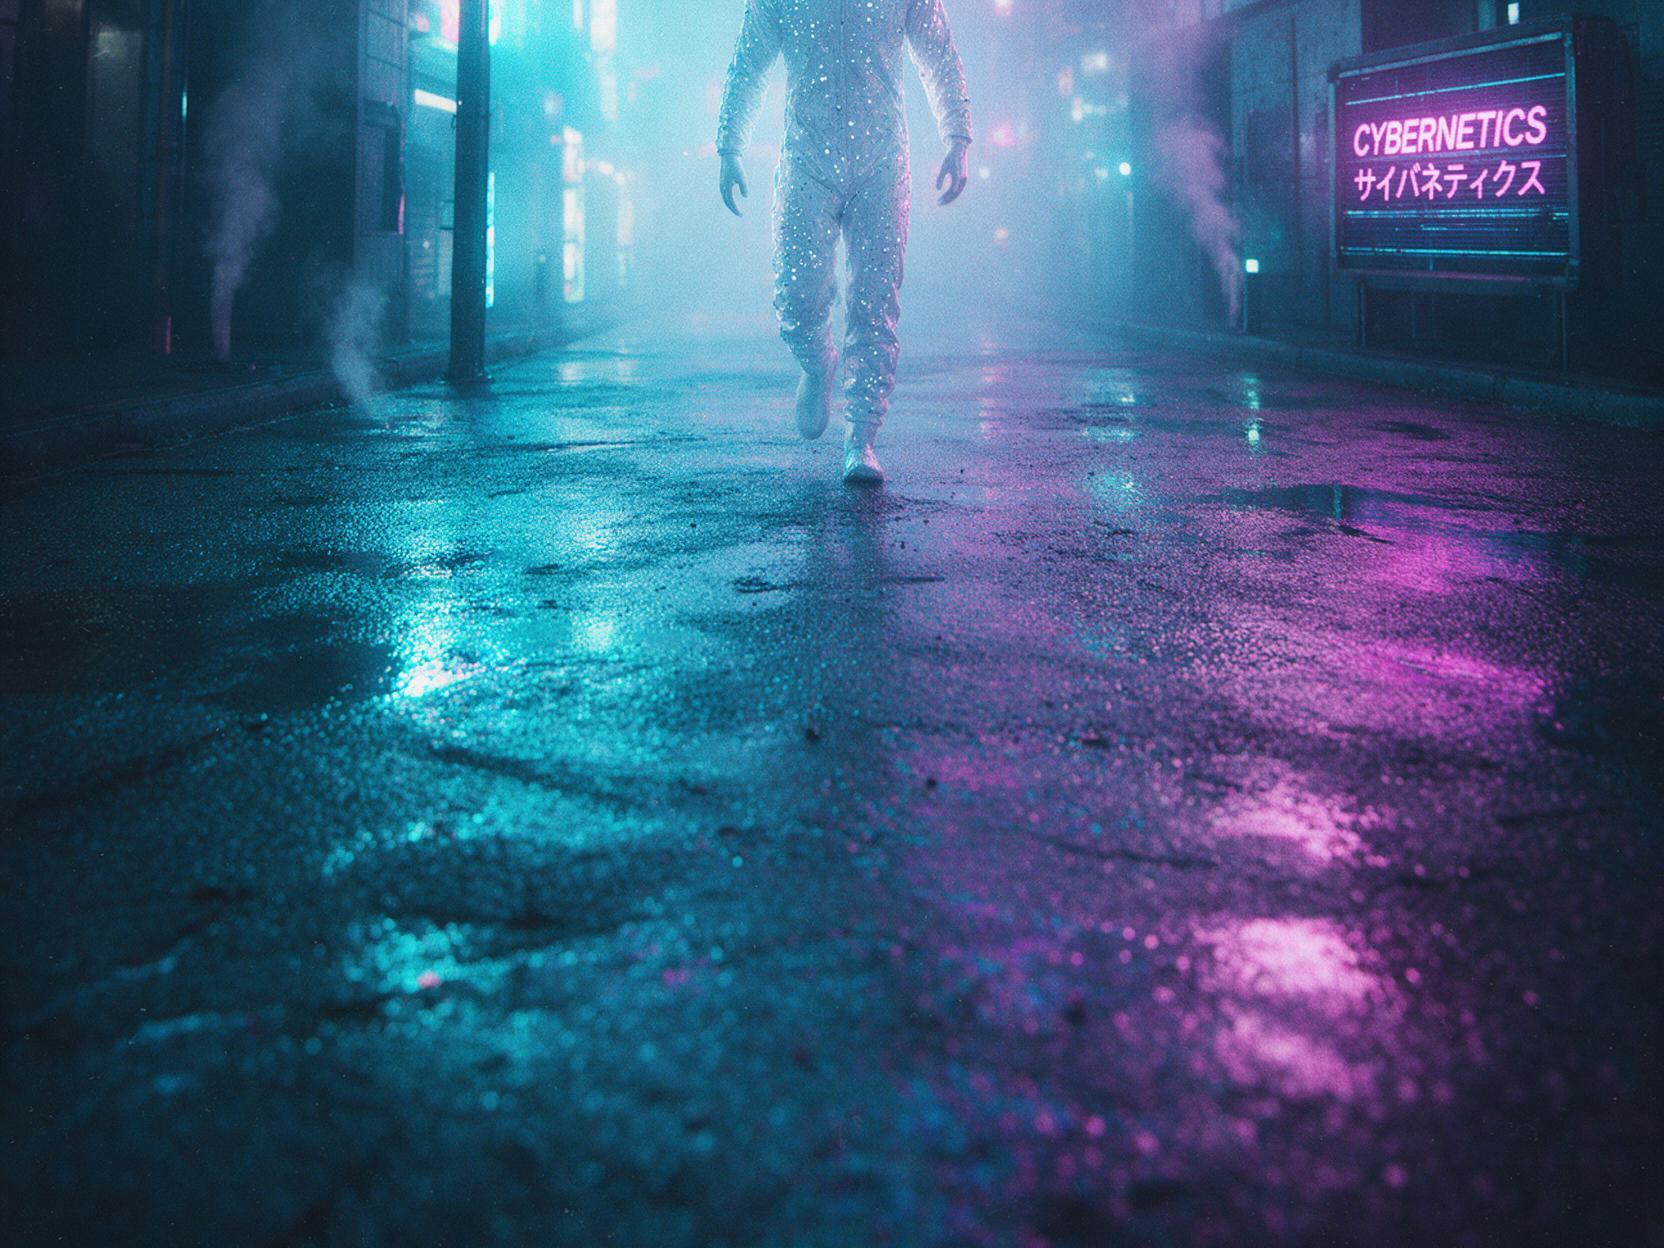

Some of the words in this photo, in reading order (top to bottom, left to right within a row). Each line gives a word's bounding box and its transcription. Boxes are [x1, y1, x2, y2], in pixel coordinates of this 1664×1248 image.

[1353, 105, 1548, 157] CYBERNETICS
[1354, 160, 1546, 201] サイバネティクス
